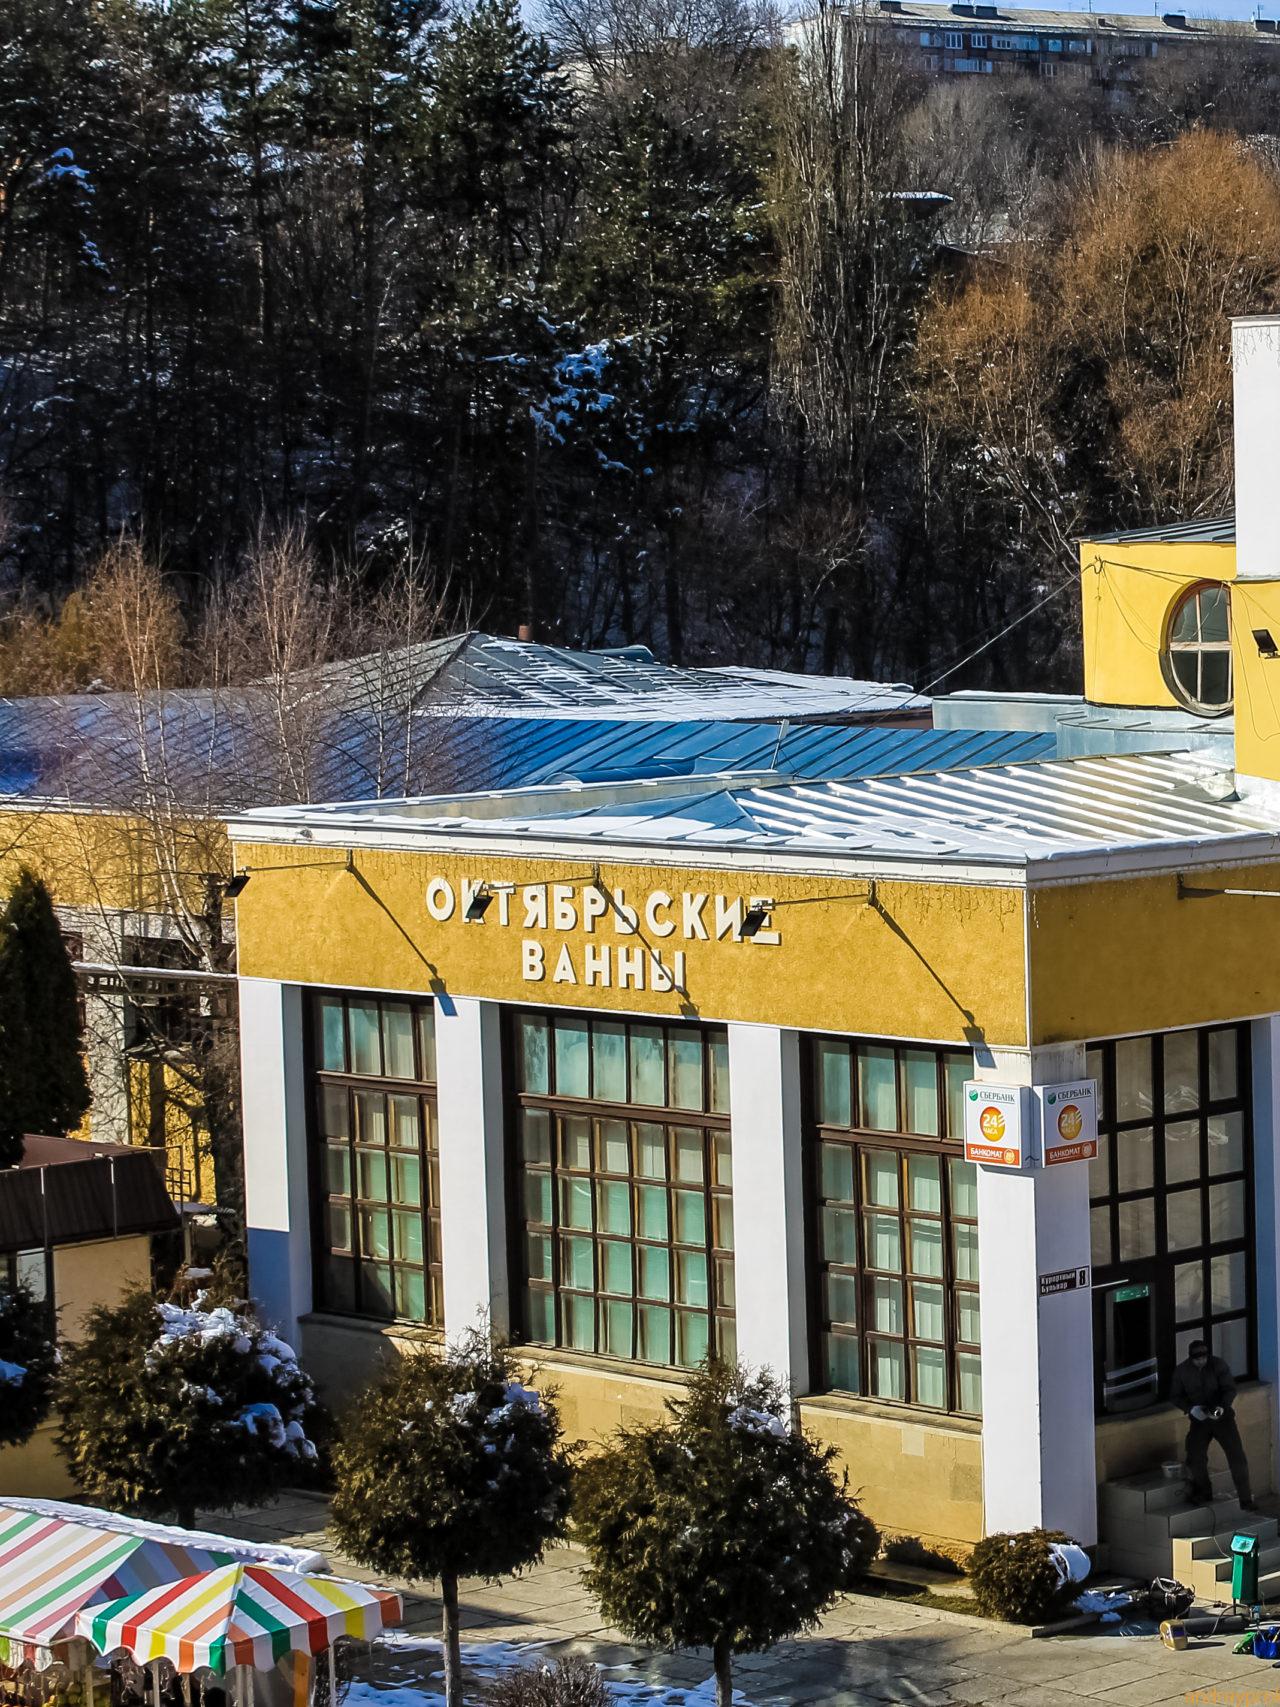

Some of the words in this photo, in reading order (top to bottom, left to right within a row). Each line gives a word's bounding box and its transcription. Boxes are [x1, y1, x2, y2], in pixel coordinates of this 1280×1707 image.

[425, 875, 782, 947] ОКТЯБРЬСКИЕ
[521, 939, 686, 993] ВАННЫ
[980, 1091, 1015, 1102] СБЕРБАНК
[1057, 1088, 1092, 1100] СБЕРБАНК
[983, 1113, 998, 1127] 24
[1061, 1113, 1075, 1127] 24
[970, 1147, 1003, 1159] БАНКОМАТ
[1050, 1147, 1081, 1159] БАНКОМАТ
